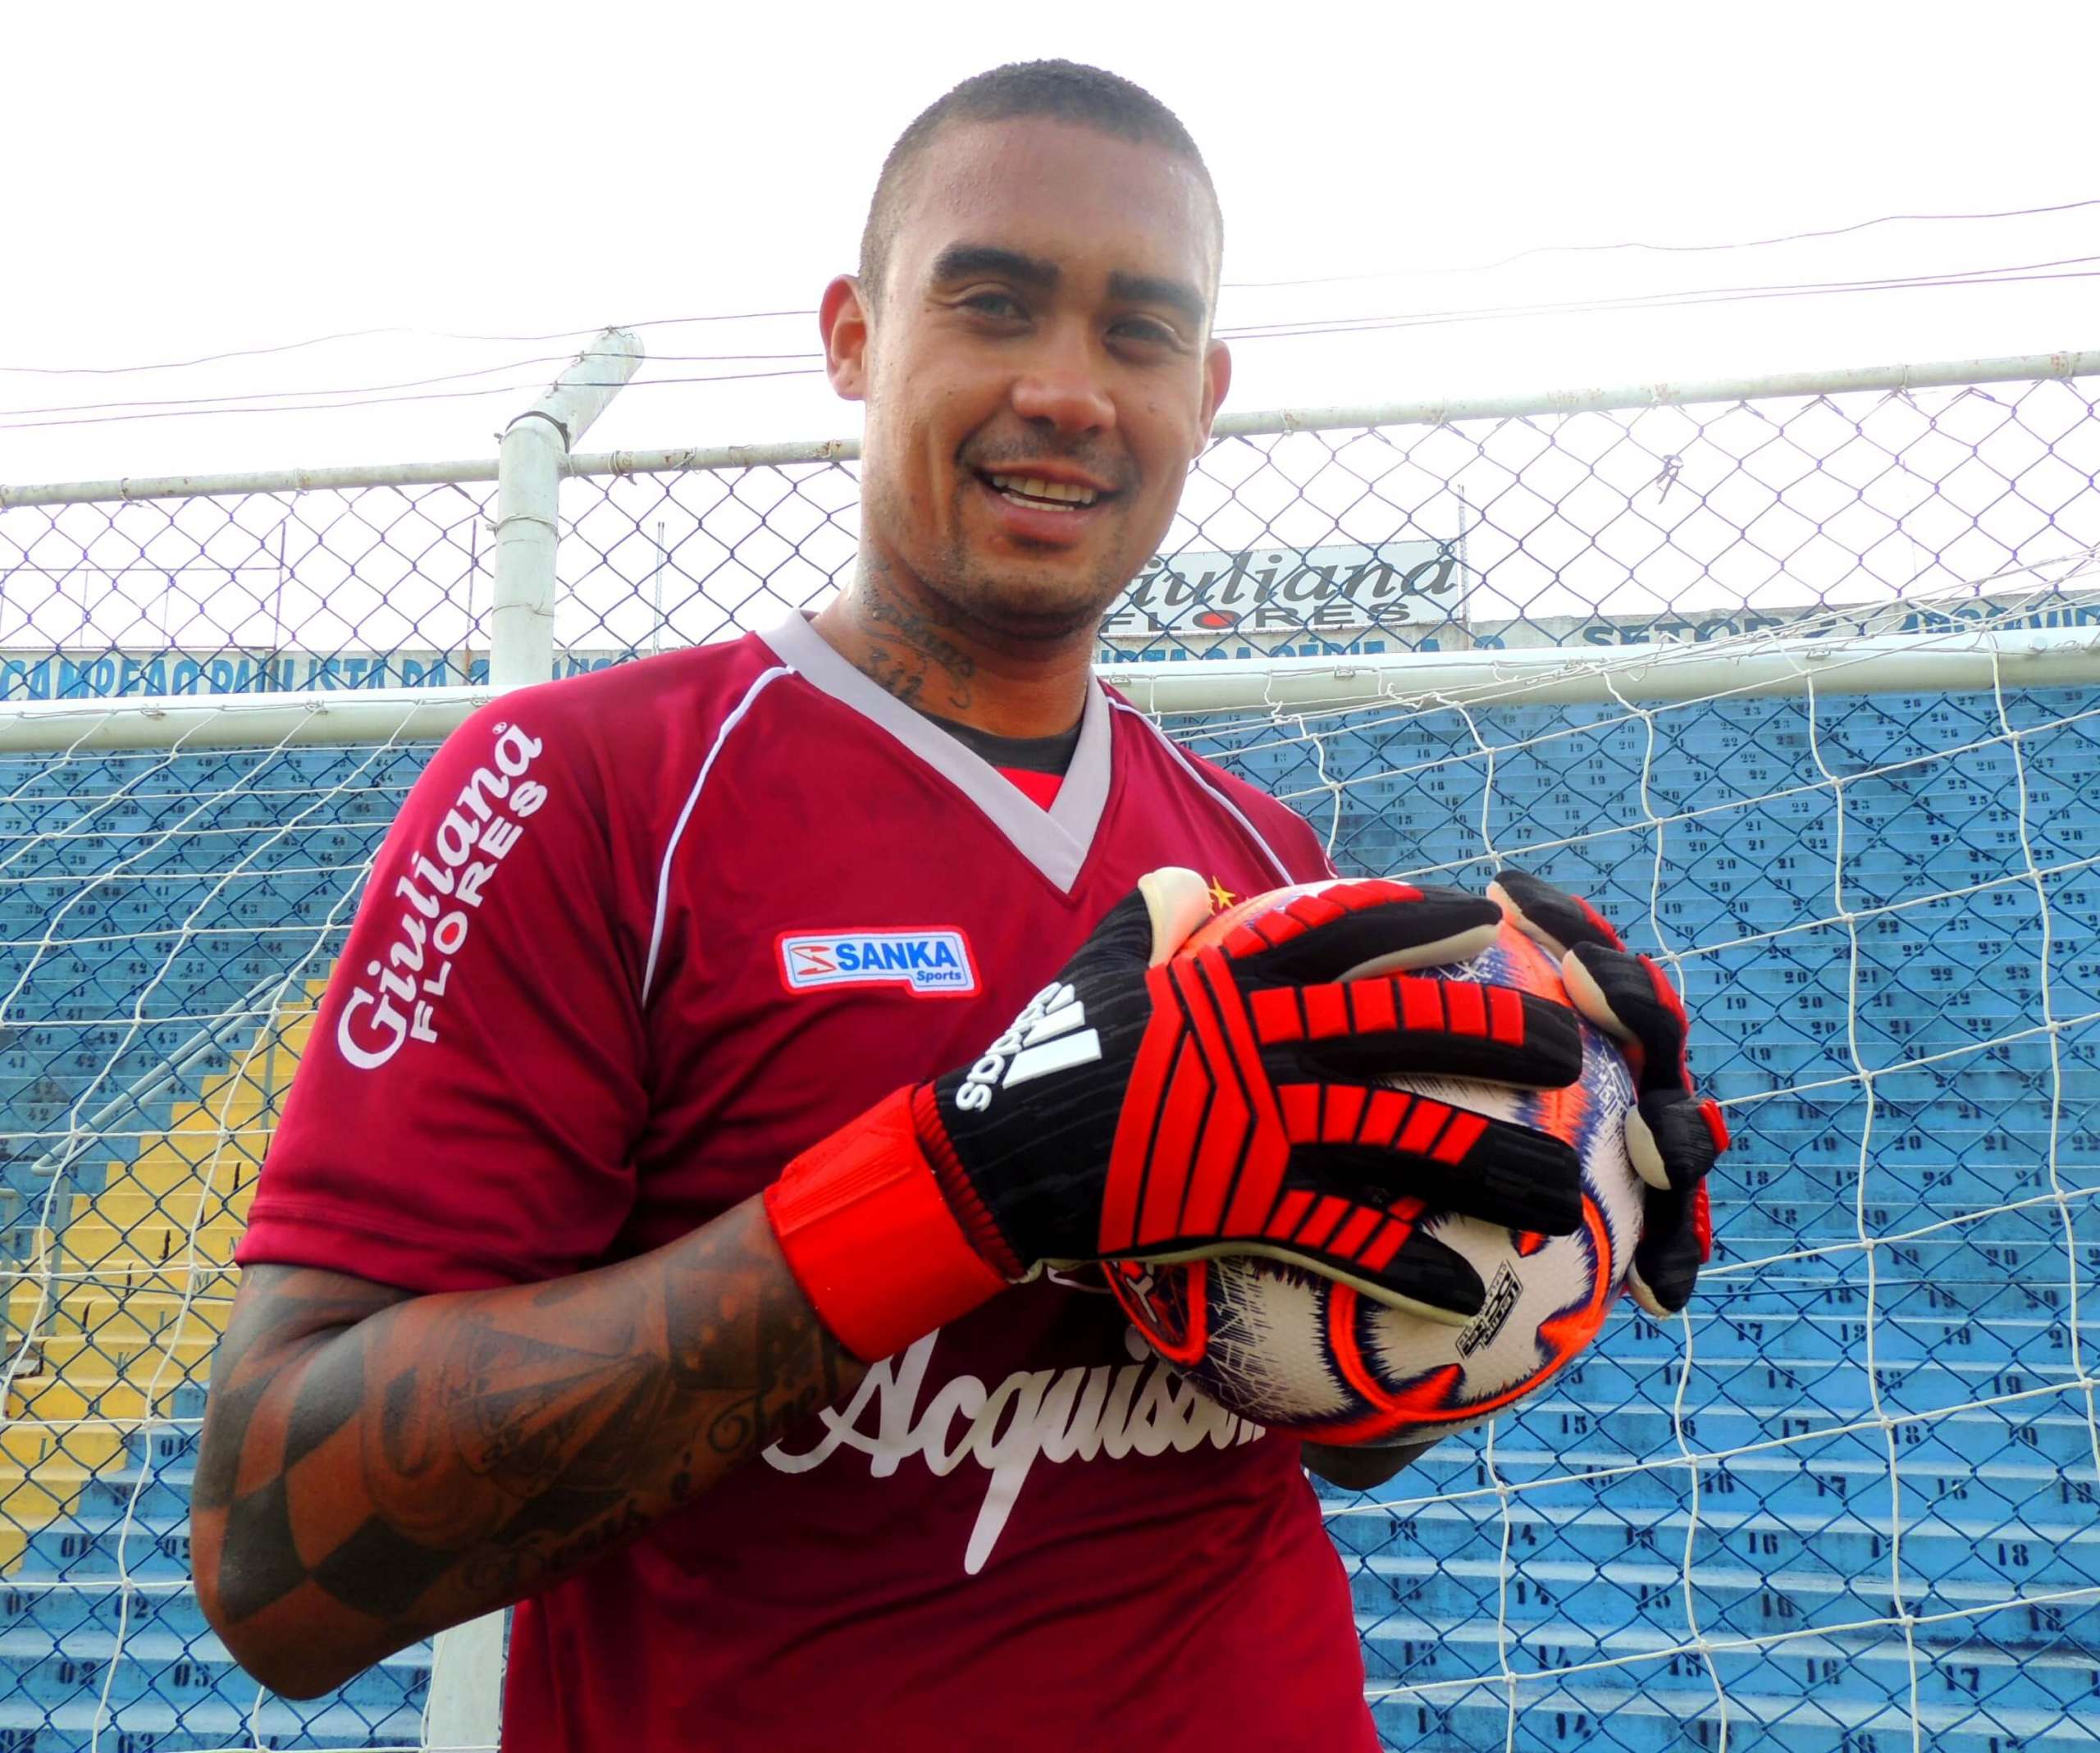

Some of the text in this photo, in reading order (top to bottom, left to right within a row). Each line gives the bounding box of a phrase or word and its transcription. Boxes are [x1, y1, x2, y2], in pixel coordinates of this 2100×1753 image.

[1137, 551, 1457, 607] iuliana
[1100, 601, 1410, 632] FLORES
[1746, 821, 1760, 830] 21
[1518, 829, 1531, 838] 17
[1690, 842, 1707, 851] 20
[1749, 840, 1764, 849] 21
[1809, 838, 1827, 848] 22
[1717, 860, 1736, 869] 20
[1778, 858, 1794, 868] 21
[1477, 866, 1491, 875] 16
[1710, 882, 1730, 892] 20
[134, 904, 147, 912] 41
[409, 780, 548, 1043] FLORES
[1665, 903, 1682, 913] 19
[1879, 921, 1899, 933] 22
[1979, 943, 2001, 954] 23
[835, 941, 959, 970] SANKA
[916, 970, 961, 983] Sports
[1785, 972, 1808, 983] 20
[1931, 969, 1952, 980] 22
[2006, 967, 2029, 979] 23
[1727, 998, 1746, 1009] 19
[1799, 997, 1822, 1008] 20
[5, 1008, 25, 1019] 40
[1811, 1022, 1836, 1034] 20
[1968, 1019, 1992, 1031] 22
[956, 981, 1062, 1112] adidas
[1751, 1048, 1771, 1060] 19
[8, 1057, 25, 1068] 41
[1746, 1171, 1768, 1185] 18
[1994, 1376, 2020, 1394] 19
[1562, 1414, 1586, 1433] 15
[1783, 1420, 1809, 1437] 17
[1892, 1425, 1920, 1444] 18
[62, 1537, 88, 1557] 01
[1749, 1533, 1778, 1554] 16
[1998, 1544, 2028, 1566] 18
[1763, 1594, 1793, 1617] 16
[60, 1662, 95, 1684] 02
[1808, 1659, 1840, 1683] 16
[1946, 1666, 1979, 1691] 17
